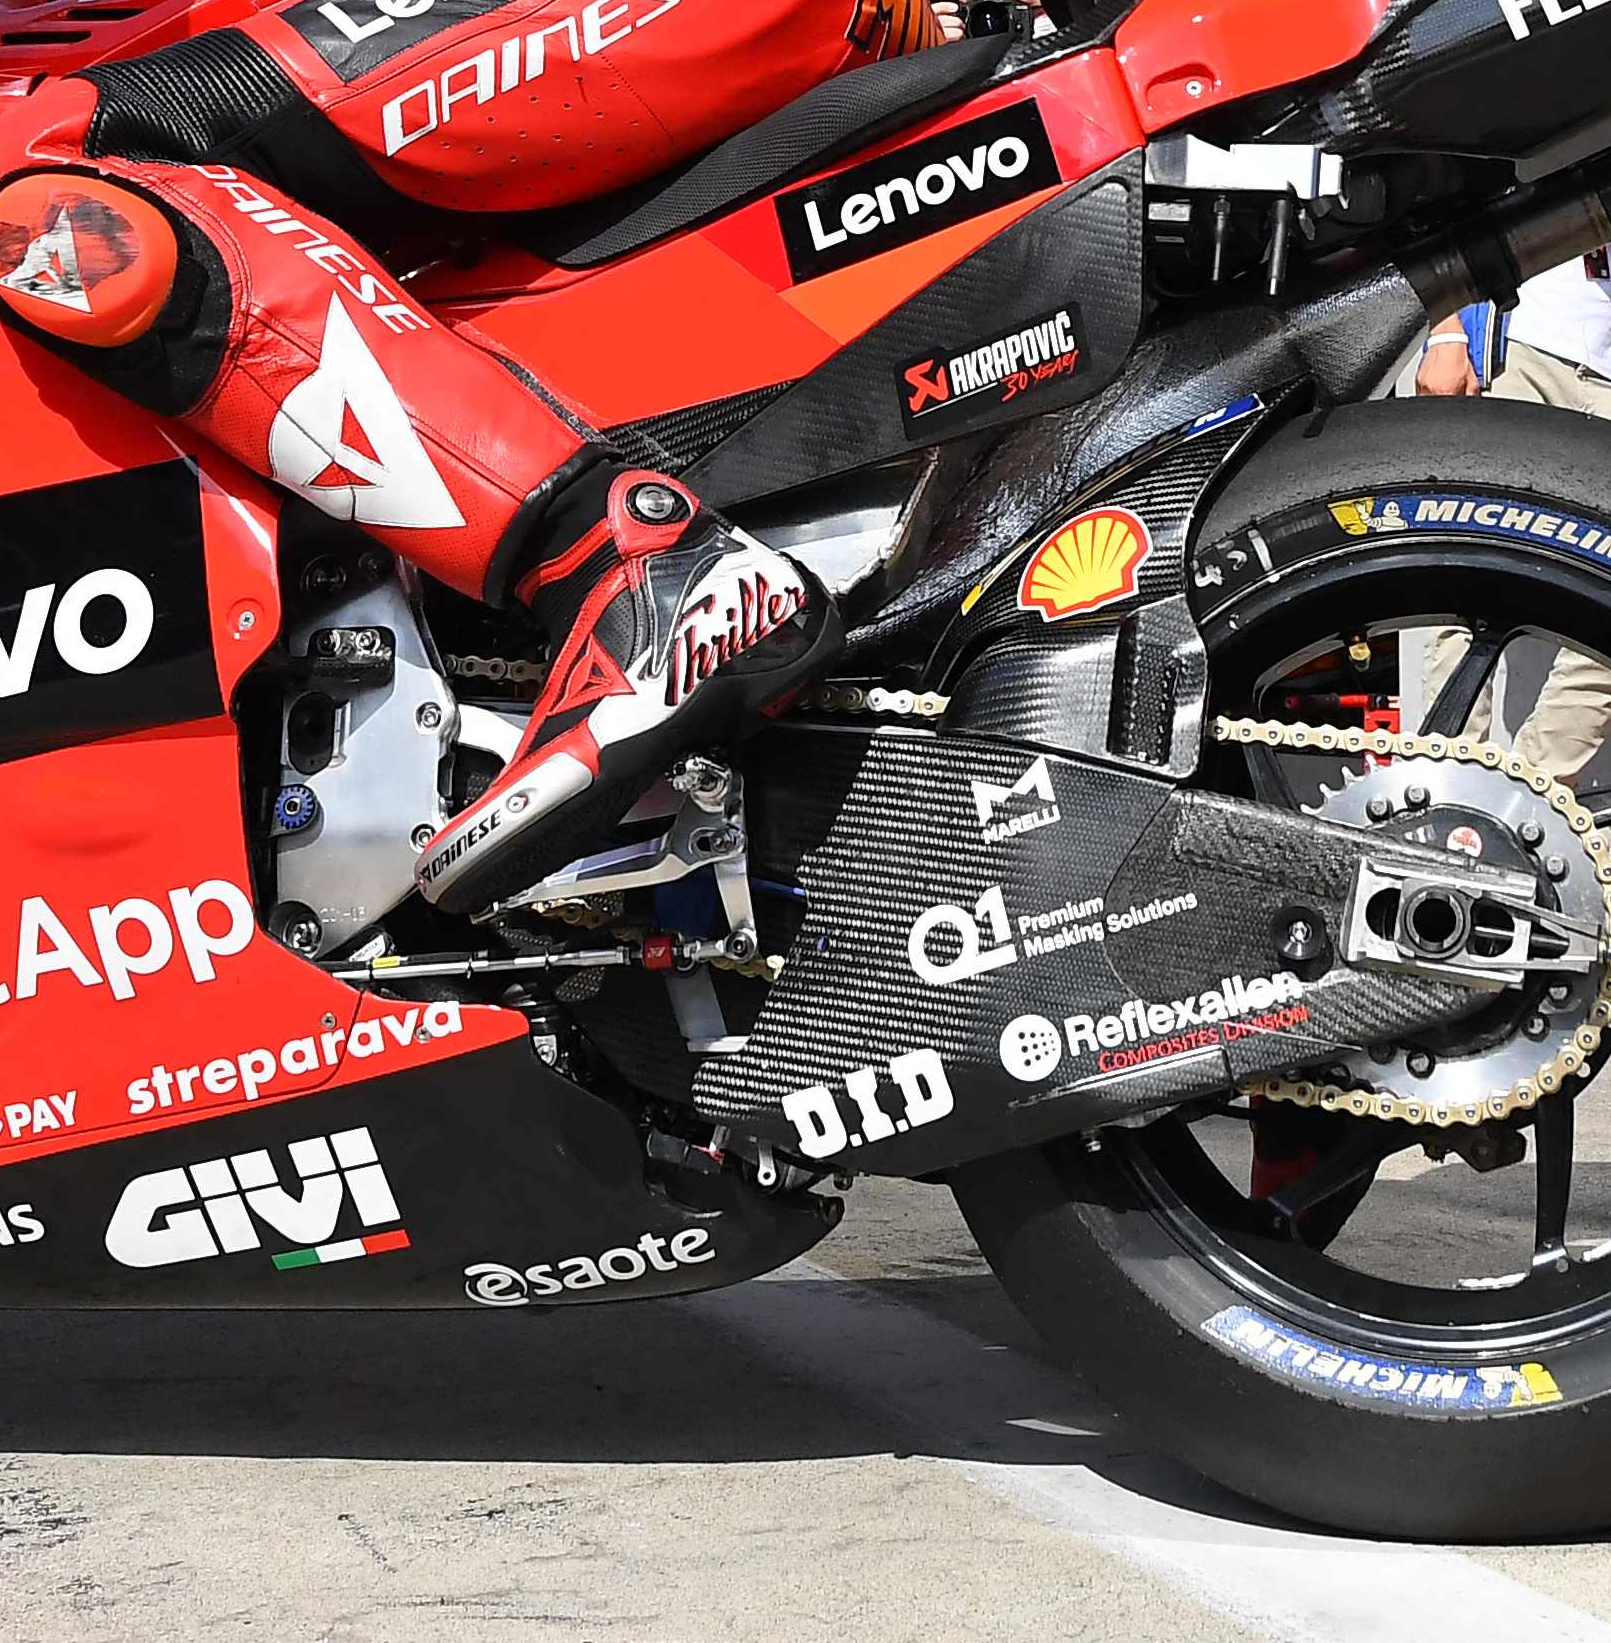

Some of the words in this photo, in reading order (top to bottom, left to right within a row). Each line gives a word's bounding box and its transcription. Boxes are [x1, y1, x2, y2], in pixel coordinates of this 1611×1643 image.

[804, 136, 1030, 251] Lenovo
[190, 164, 431, 335] DAINESE
[1000, 371, 1029, 402] 30
[665, 571, 806, 707] Thriller
[430, 808, 503, 880] DAINESE
[981, 804, 1061, 845] MARELLI
[907, 886, 1018, 986] Q1
[1018, 896, 1105, 936] Premium
[1023, 921, 1106, 958] Masking
[1106, 891, 1198, 933] Solutions
[127, 1000, 464, 1115] streparava
[1097, 1026, 1222, 1073] COMPOSITES
[6, 1090, 78, 1141] PAY
[781, 1046, 957, 1160] D.I.D
[104, 1125, 402, 1269] GIVI
[1234, 1318, 1469, 1400] MICHELIN
